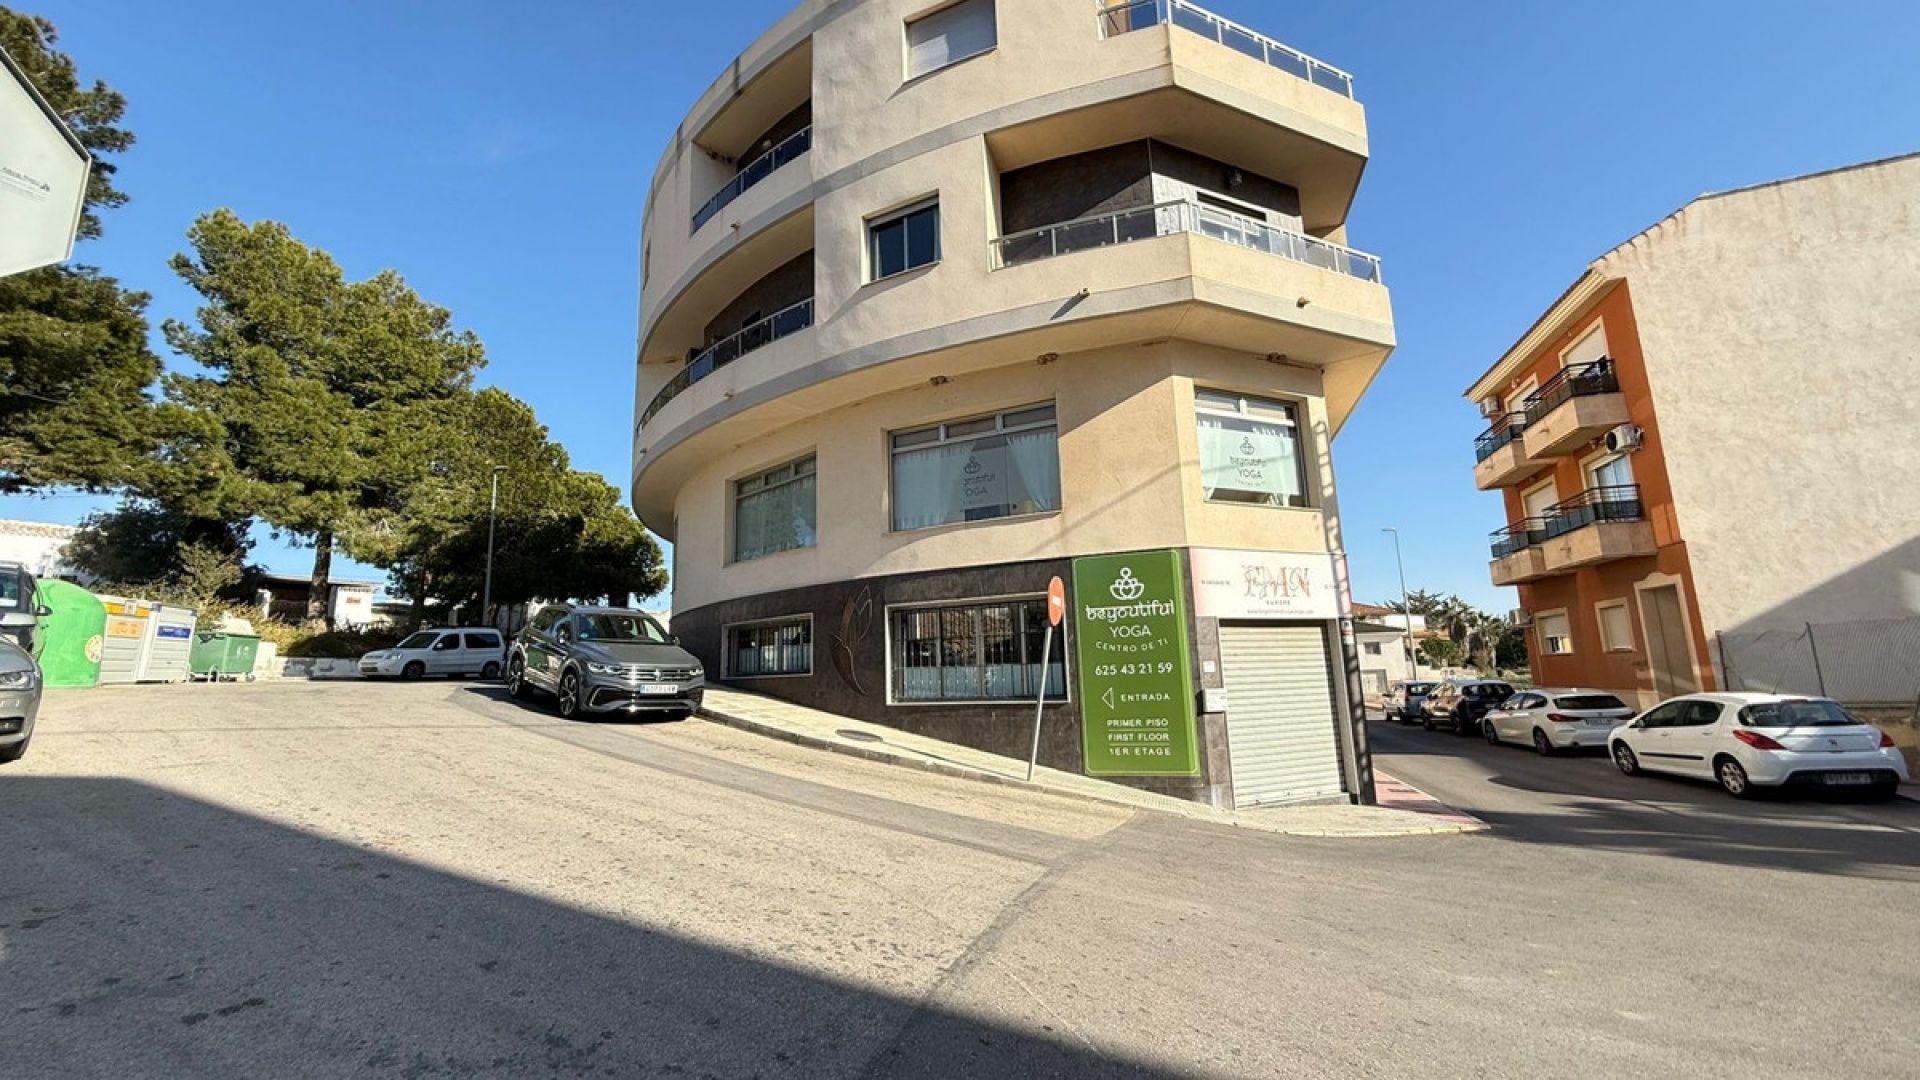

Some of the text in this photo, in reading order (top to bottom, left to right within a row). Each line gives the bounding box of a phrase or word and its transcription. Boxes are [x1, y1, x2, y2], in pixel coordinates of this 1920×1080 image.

[1237, 469, 1262, 479] YOGA
[1085, 599, 1175, 623] beyoutiful
[1109, 624, 1152, 638] YOGA
[1095, 641, 1137, 653] CENTRO
[1140, 641, 1155, 652] DE
[1095, 662, 1173, 676] 625 43 21 59
[1120, 693, 1170, 702] ENTRADA
[1106, 718, 1169, 728] PRIMER PISO
[1108, 732, 1170, 742] FIRST FLOOR
[1109, 747, 1130, 756] 1ER
